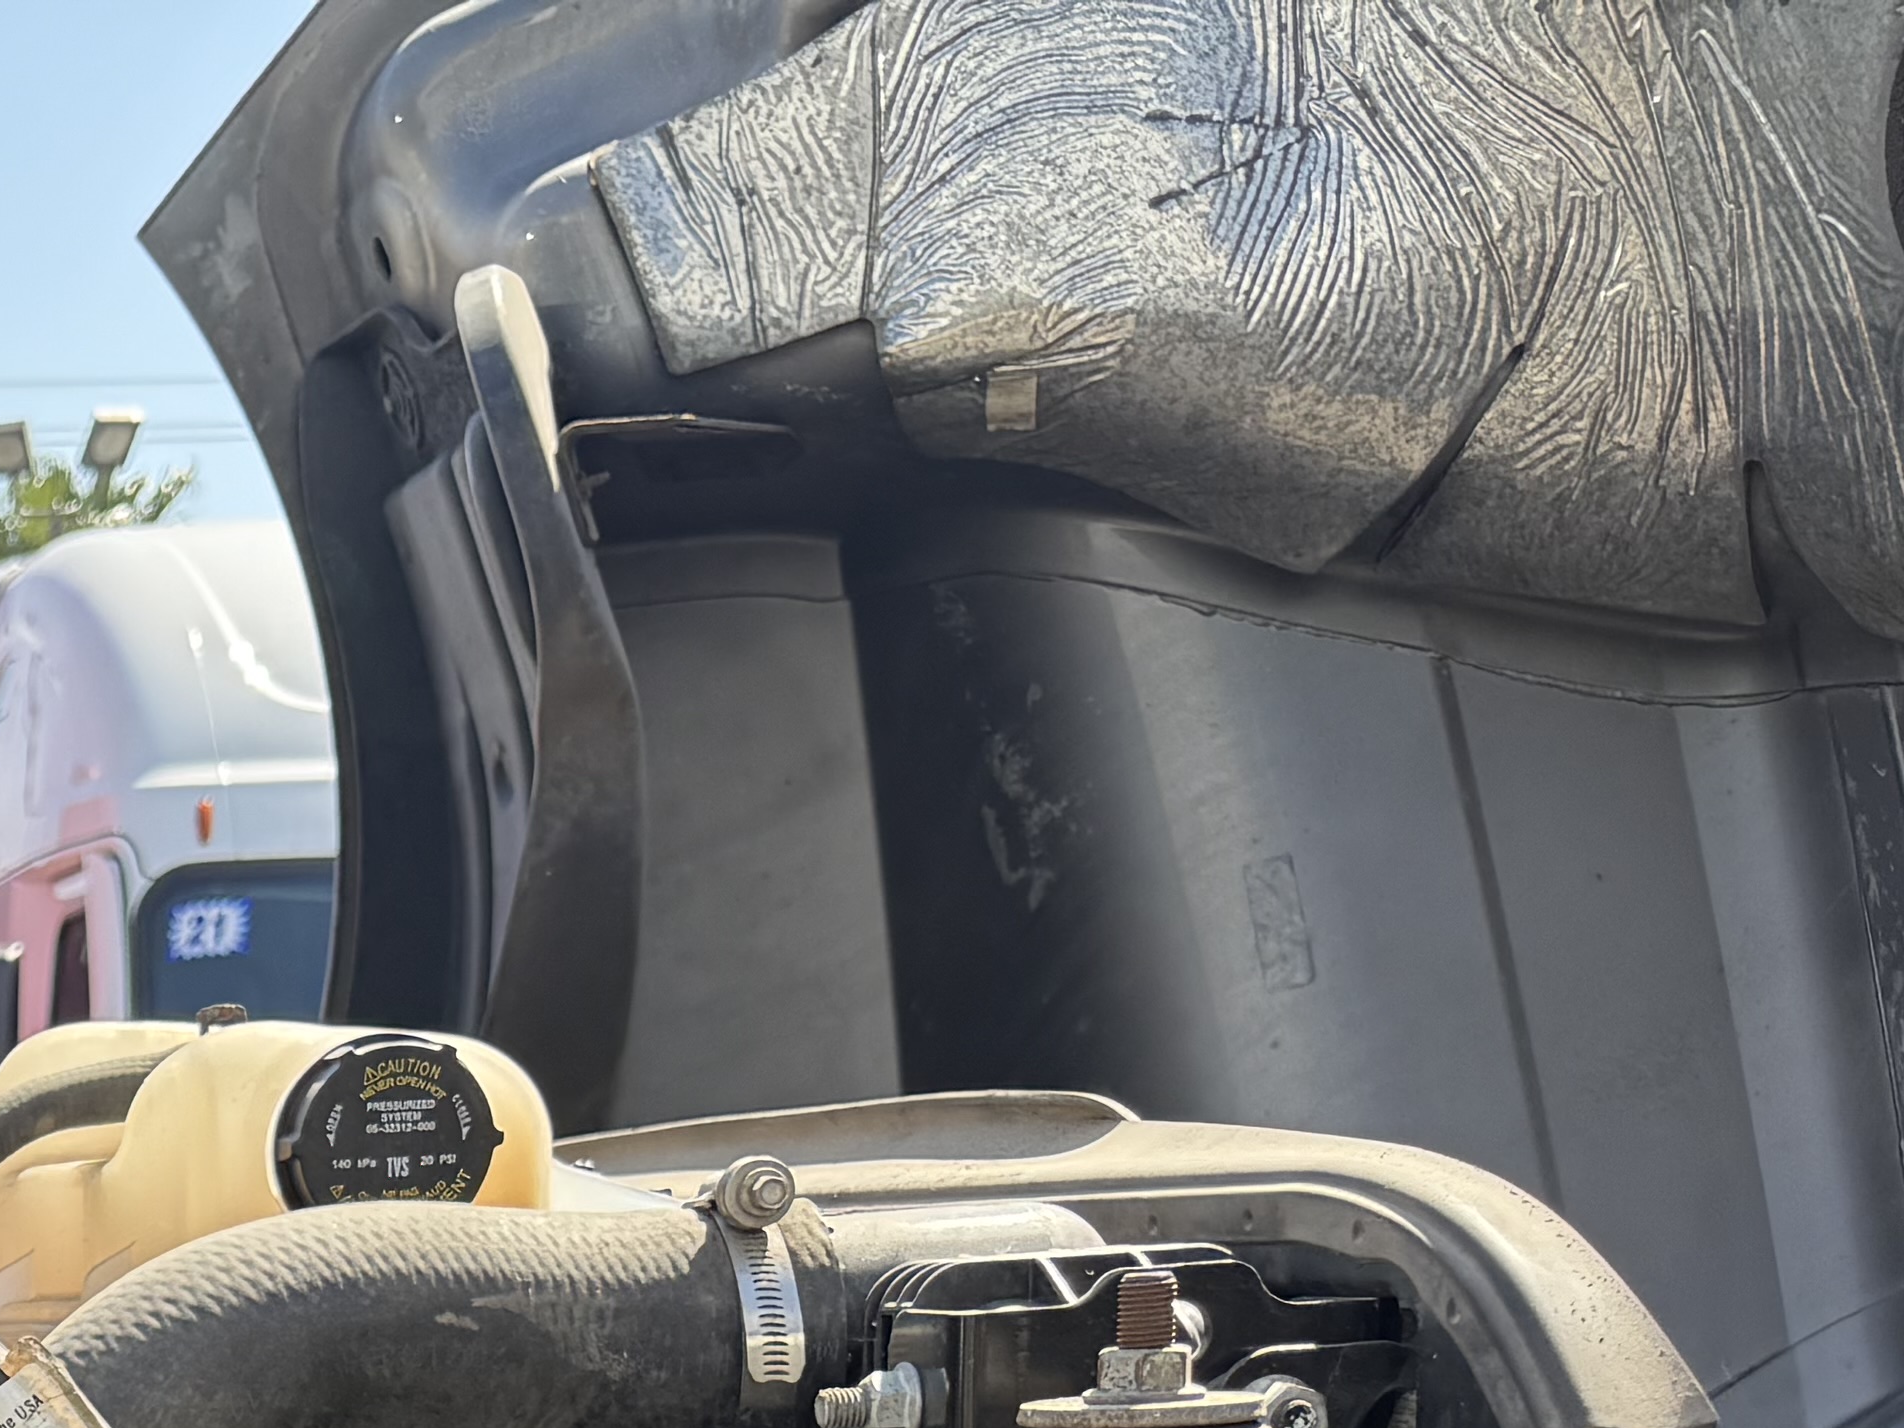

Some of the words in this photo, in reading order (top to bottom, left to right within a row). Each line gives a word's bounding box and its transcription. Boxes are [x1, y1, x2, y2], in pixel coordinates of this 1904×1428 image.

[376, 1057, 442, 1080] CAUTION
[359, 1077, 396, 1102] NEVER
[395, 1076, 427, 1091] OPEN
[425, 1082, 448, 1102] HOT
[366, 1099, 436, 1112] PRESSURIZED
[381, 1110, 422, 1123] SYSTEM
[386, 1157, 410, 1178] TVS
[439, 1153, 457, 1165] PSI
[14, 1394, 43, 1420] USA
